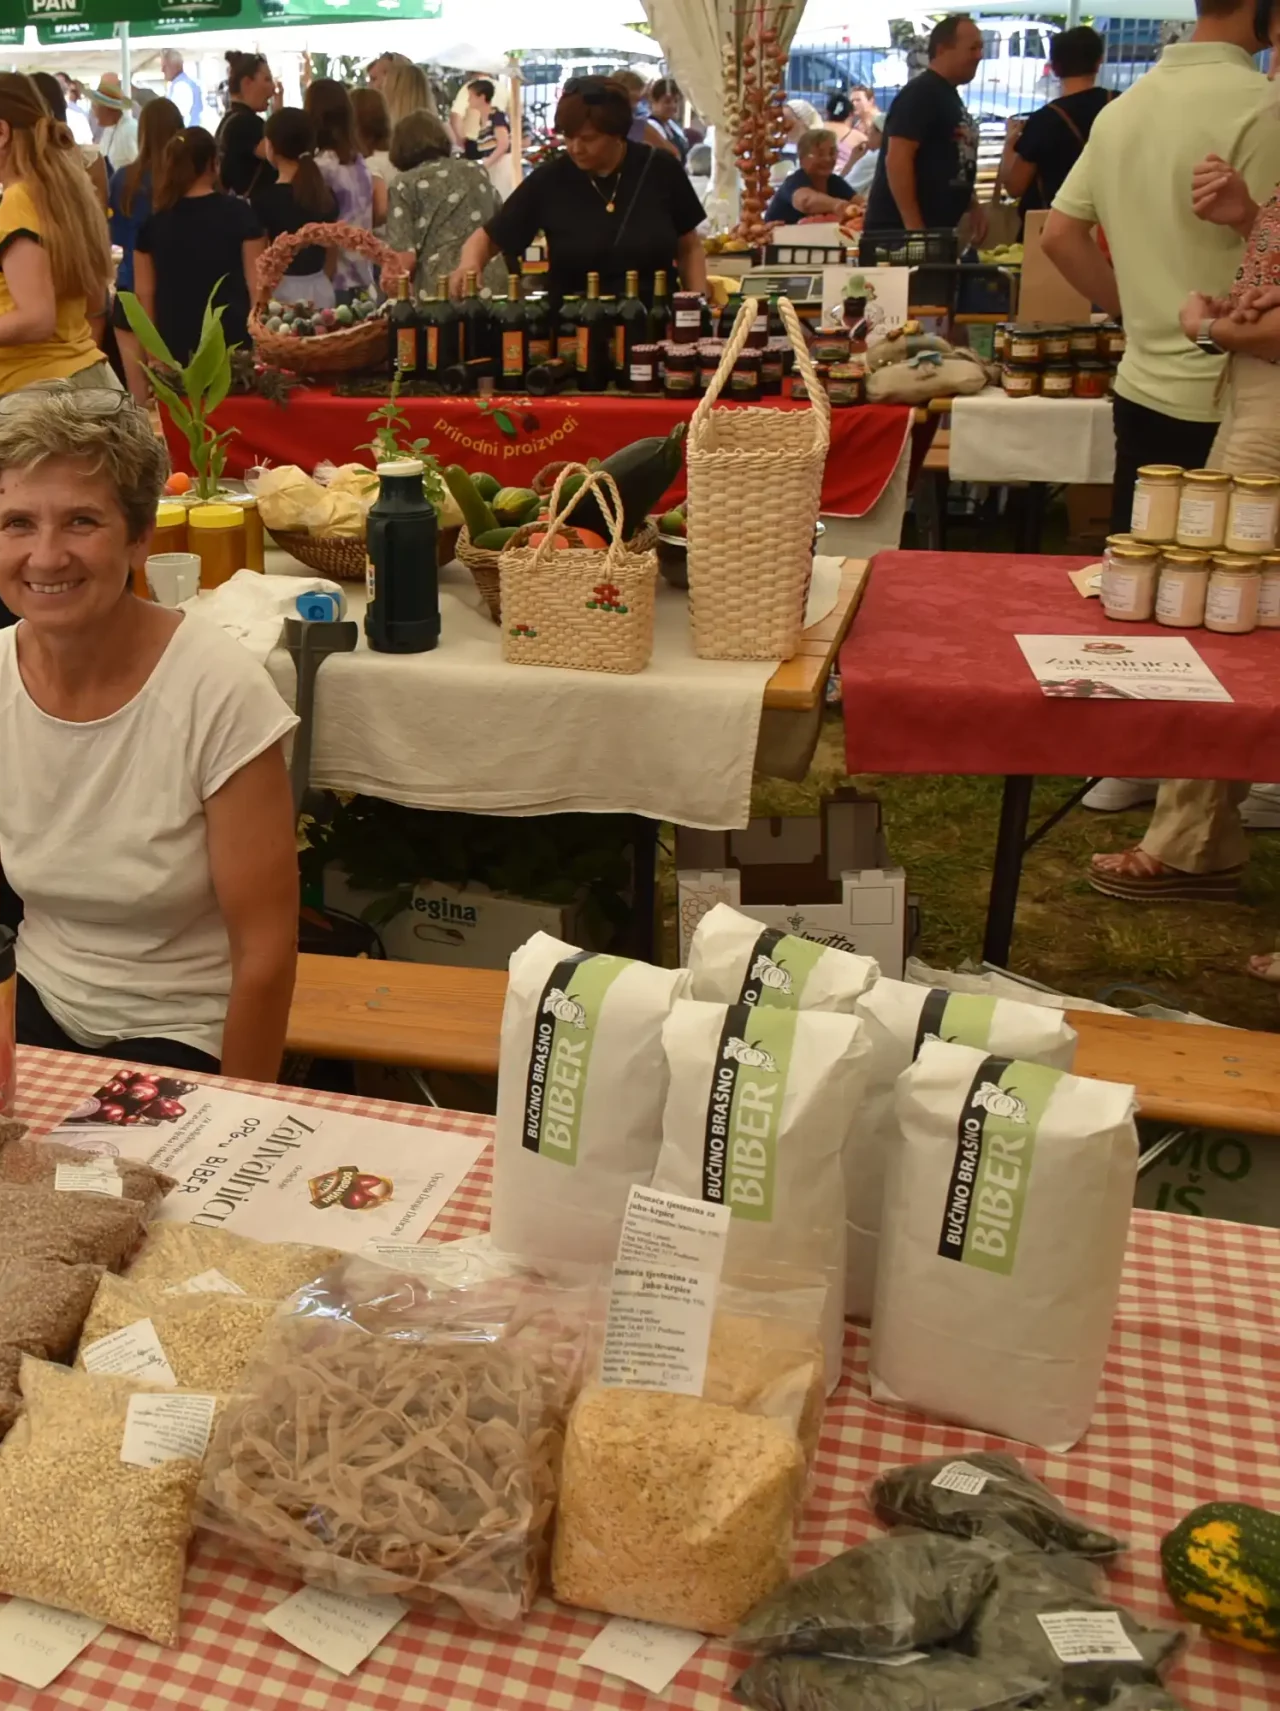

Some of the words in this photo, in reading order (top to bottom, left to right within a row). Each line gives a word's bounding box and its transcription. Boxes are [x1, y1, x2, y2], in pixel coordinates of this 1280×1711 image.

[433, 418, 498, 457] prirodni
[503, 414, 579, 460] proizvodi
[410, 897, 476, 921] egina
[533, 1023, 553, 1083] BRAŠNO
[526, 1084, 543, 1139] BUČINO
[544, 1036, 587, 1150] BIBER
[712, 1067, 735, 1136] BRAŠNO
[217, 1117, 261, 1148] OPG-u
[731, 1081, 779, 1206] BIBER
[957, 1117, 981, 1184] BRAŠNO
[177, 1155, 228, 1194] BIBER
[189, 1114, 323, 1228] Zahvalnicu
[706, 1138, 725, 1199] BUČINO
[971, 1134, 1026, 1258] BIBER
[946, 1184, 970, 1246] BUČINO
